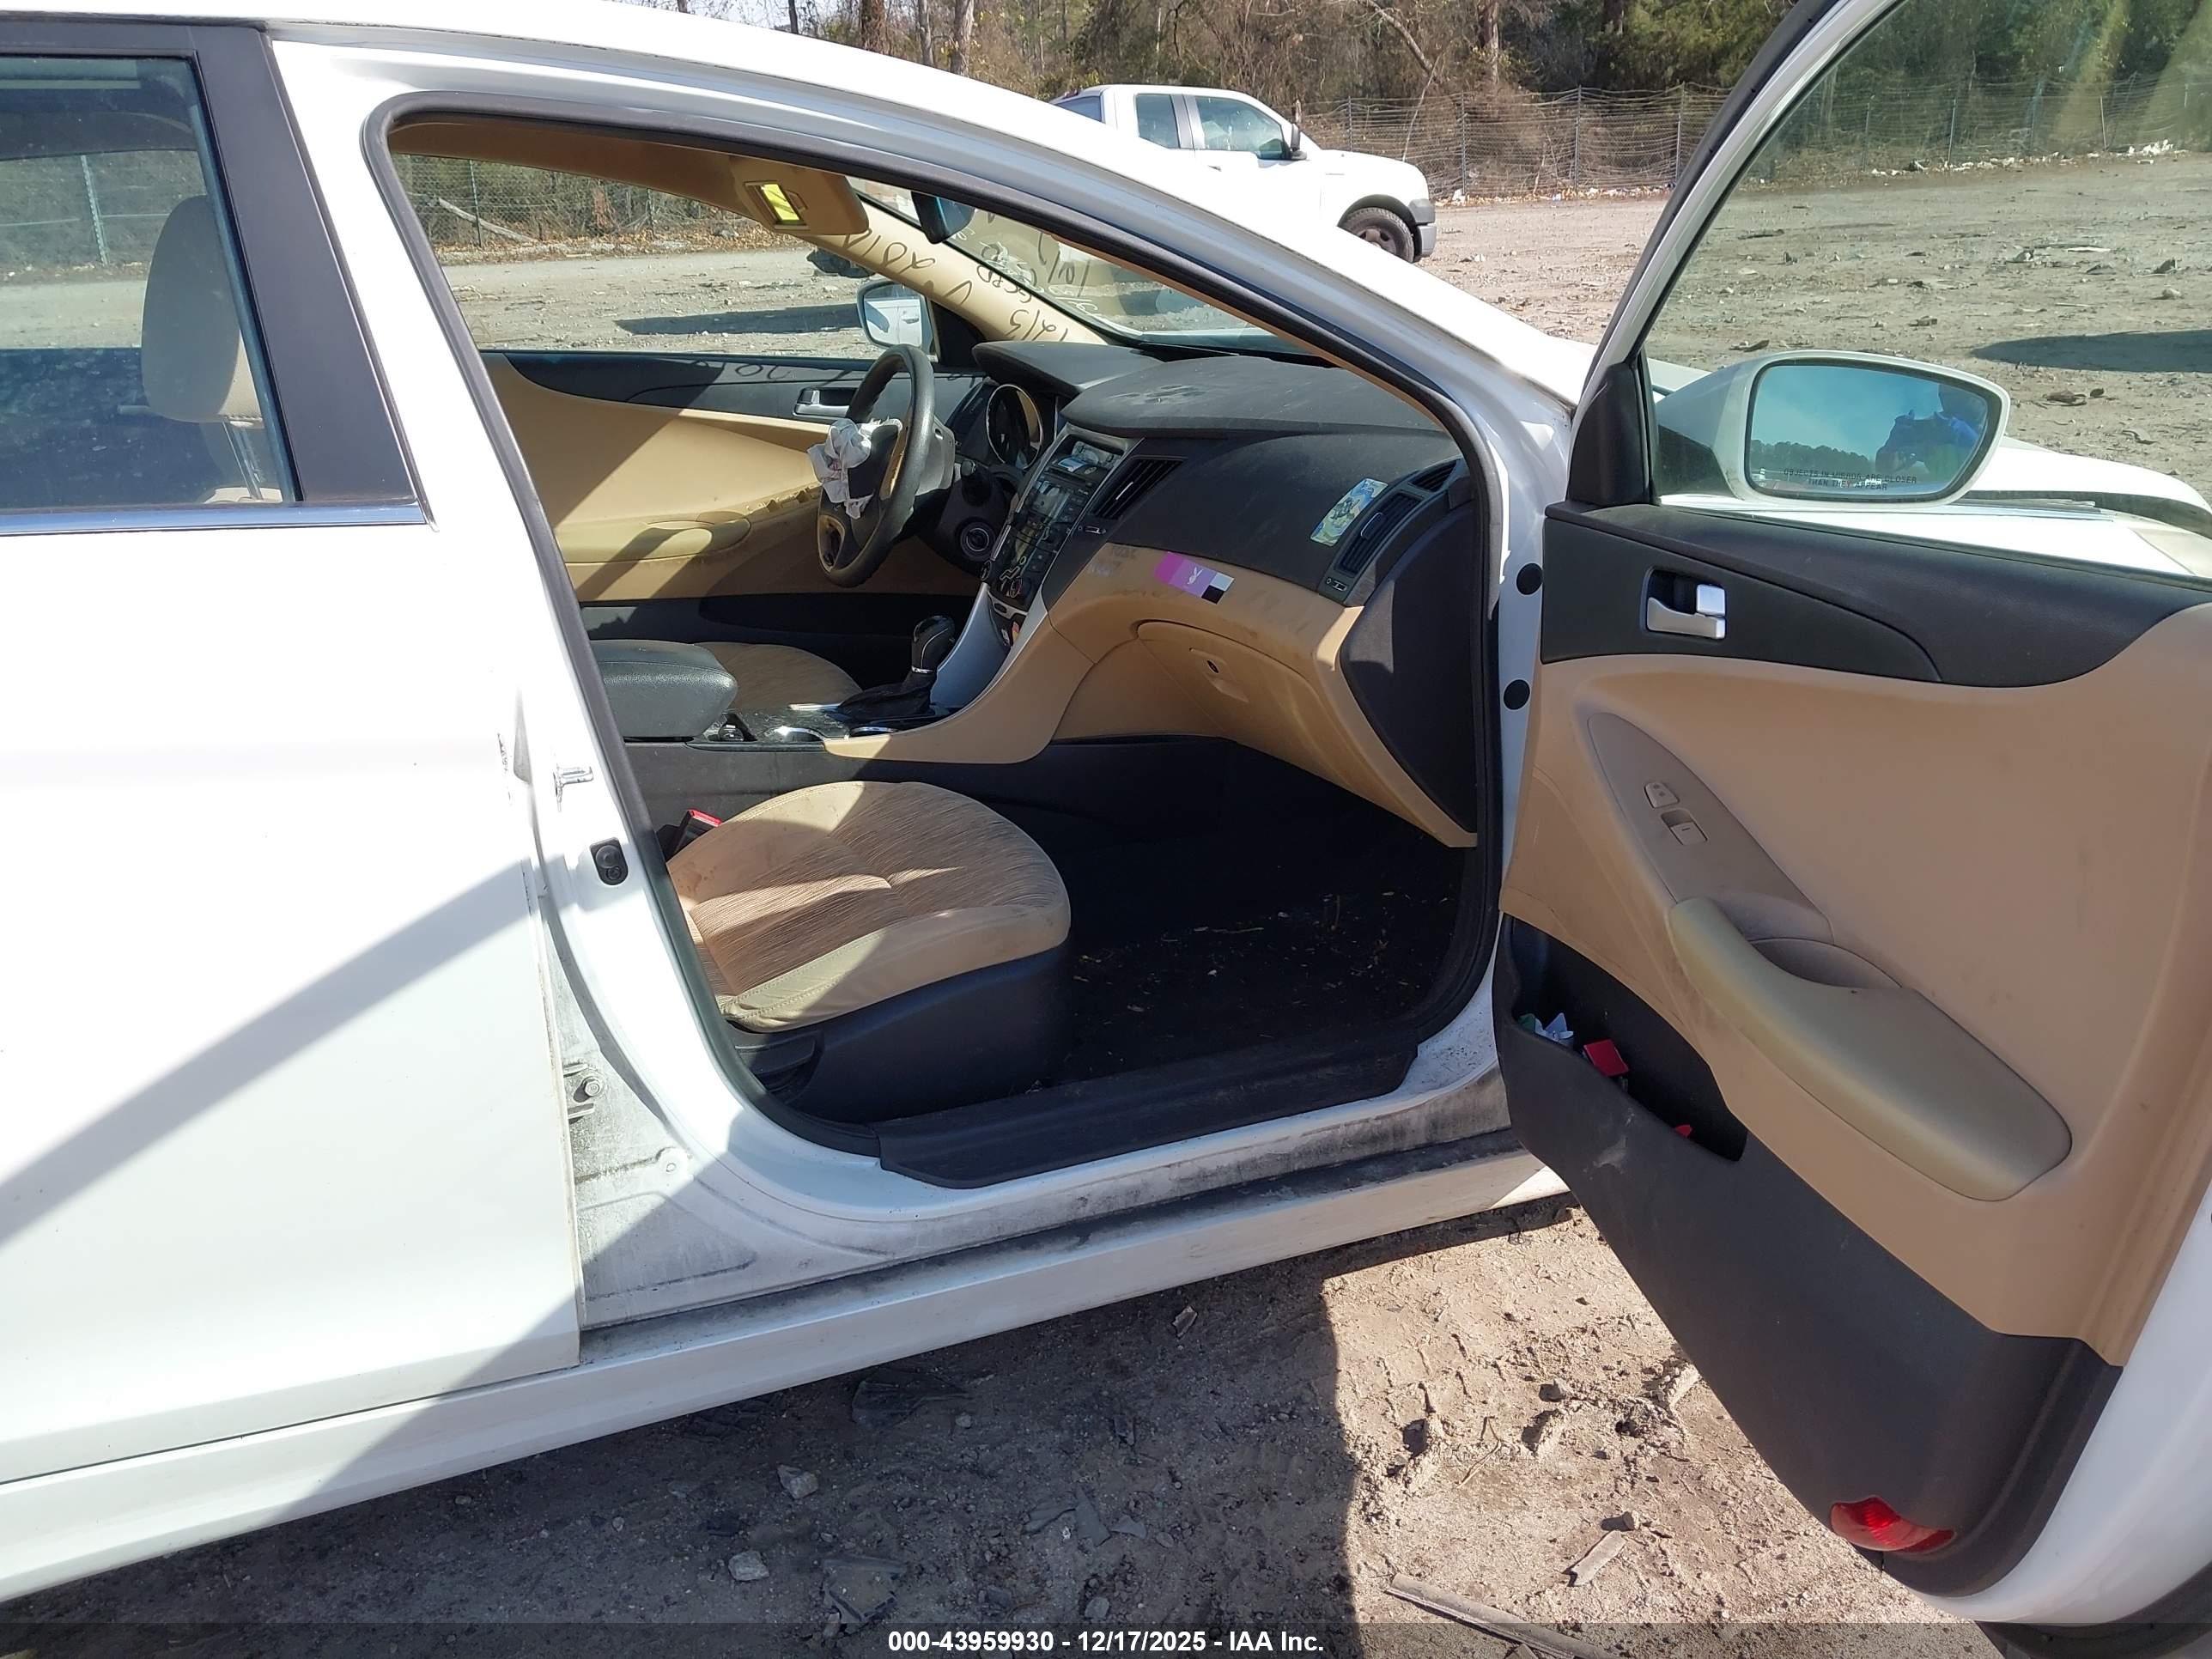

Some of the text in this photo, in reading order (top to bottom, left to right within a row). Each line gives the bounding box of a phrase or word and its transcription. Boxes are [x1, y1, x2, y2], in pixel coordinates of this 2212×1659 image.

[1784, 469, 1819, 477] OBJECTS
[1866, 473, 1882, 483] ARE
[1885, 475, 1917, 484] CLOSER
[1808, 478, 1829, 487] THAN
[1832, 480, 1852, 489] THEY
